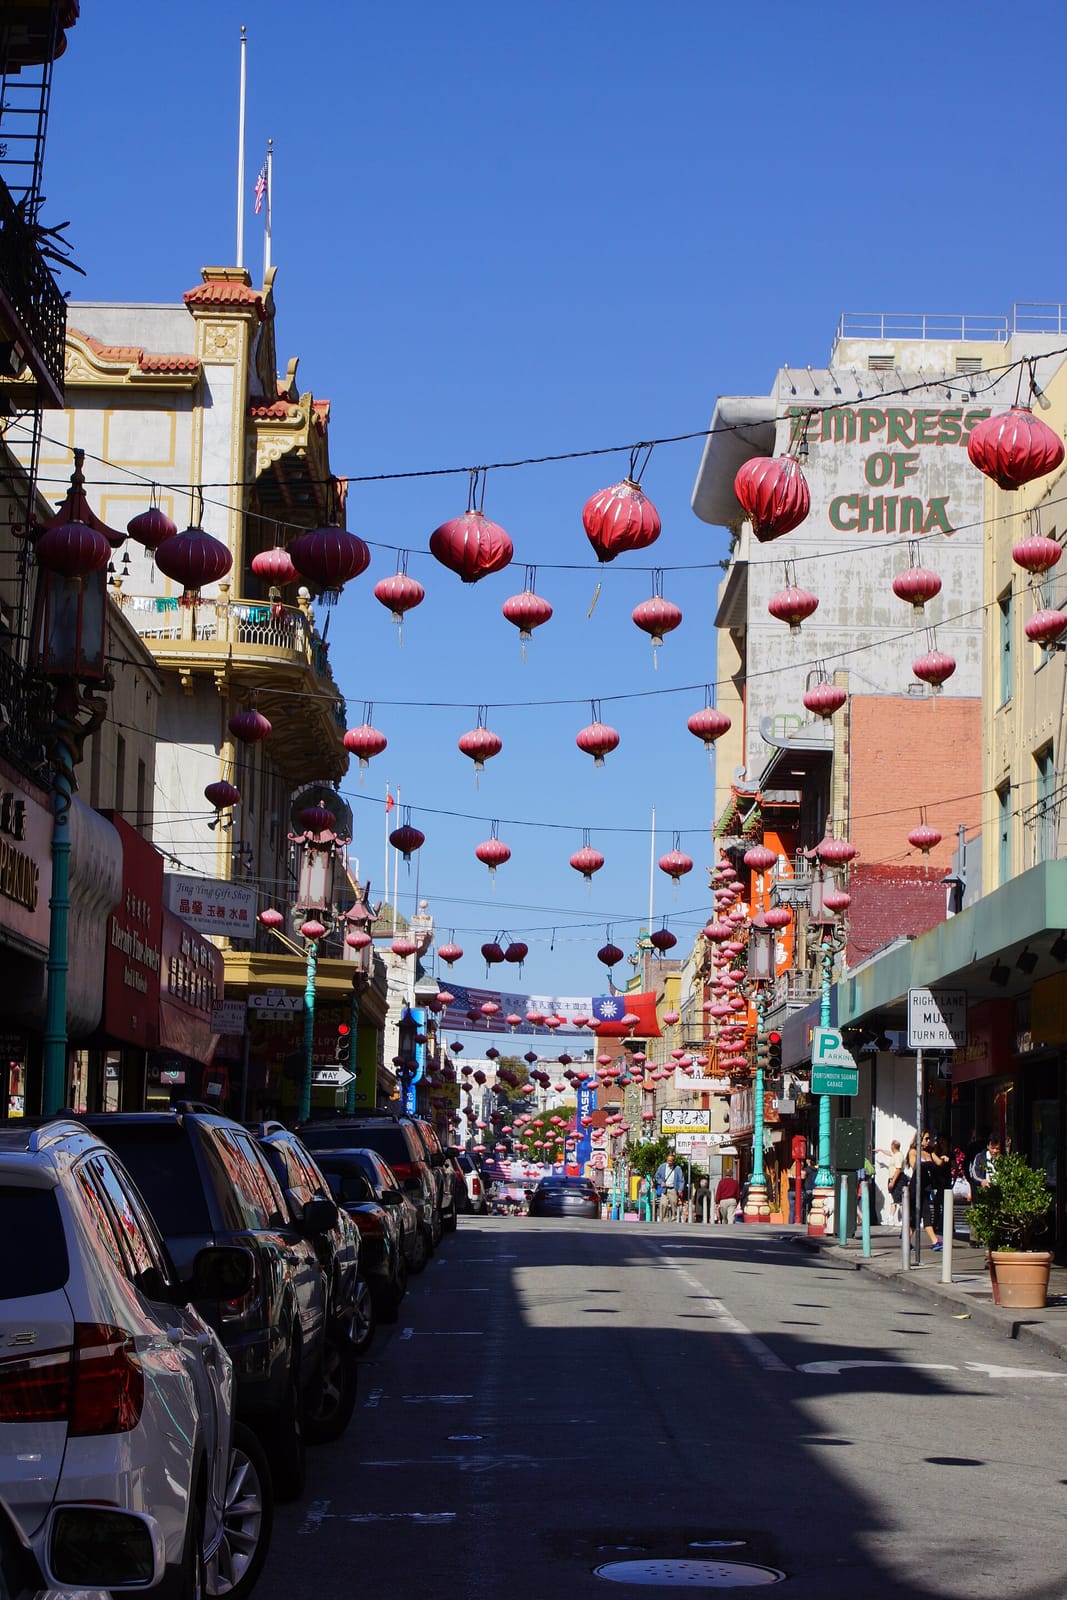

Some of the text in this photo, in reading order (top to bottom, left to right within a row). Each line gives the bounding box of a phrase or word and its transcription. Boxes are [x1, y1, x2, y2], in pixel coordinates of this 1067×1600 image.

[785, 406, 991, 448] EMPRESS
[865, 452, 920, 488] OF
[829, 494, 956, 536] CHINA
[0, 838, 39, 912] PEKING
[176, 883, 194, 897] Jing
[215, 888, 231, 900] Gift
[231, 891, 251, 903] Shop
[229, 907, 248, 921] 水晶
[254, 996, 298, 1008] CLAY
[913, 996, 964, 1007] RIGHT LANE
[923, 1012, 954, 1024] MUST
[913, 1030, 964, 1041] TURN RIGHT
[321, 1071, 338, 1080] WAY
[841, 1073, 857, 1081] SQUARE
[826, 1080, 843, 1088] GARAGE
[580, 1090, 590, 1119] HASE
